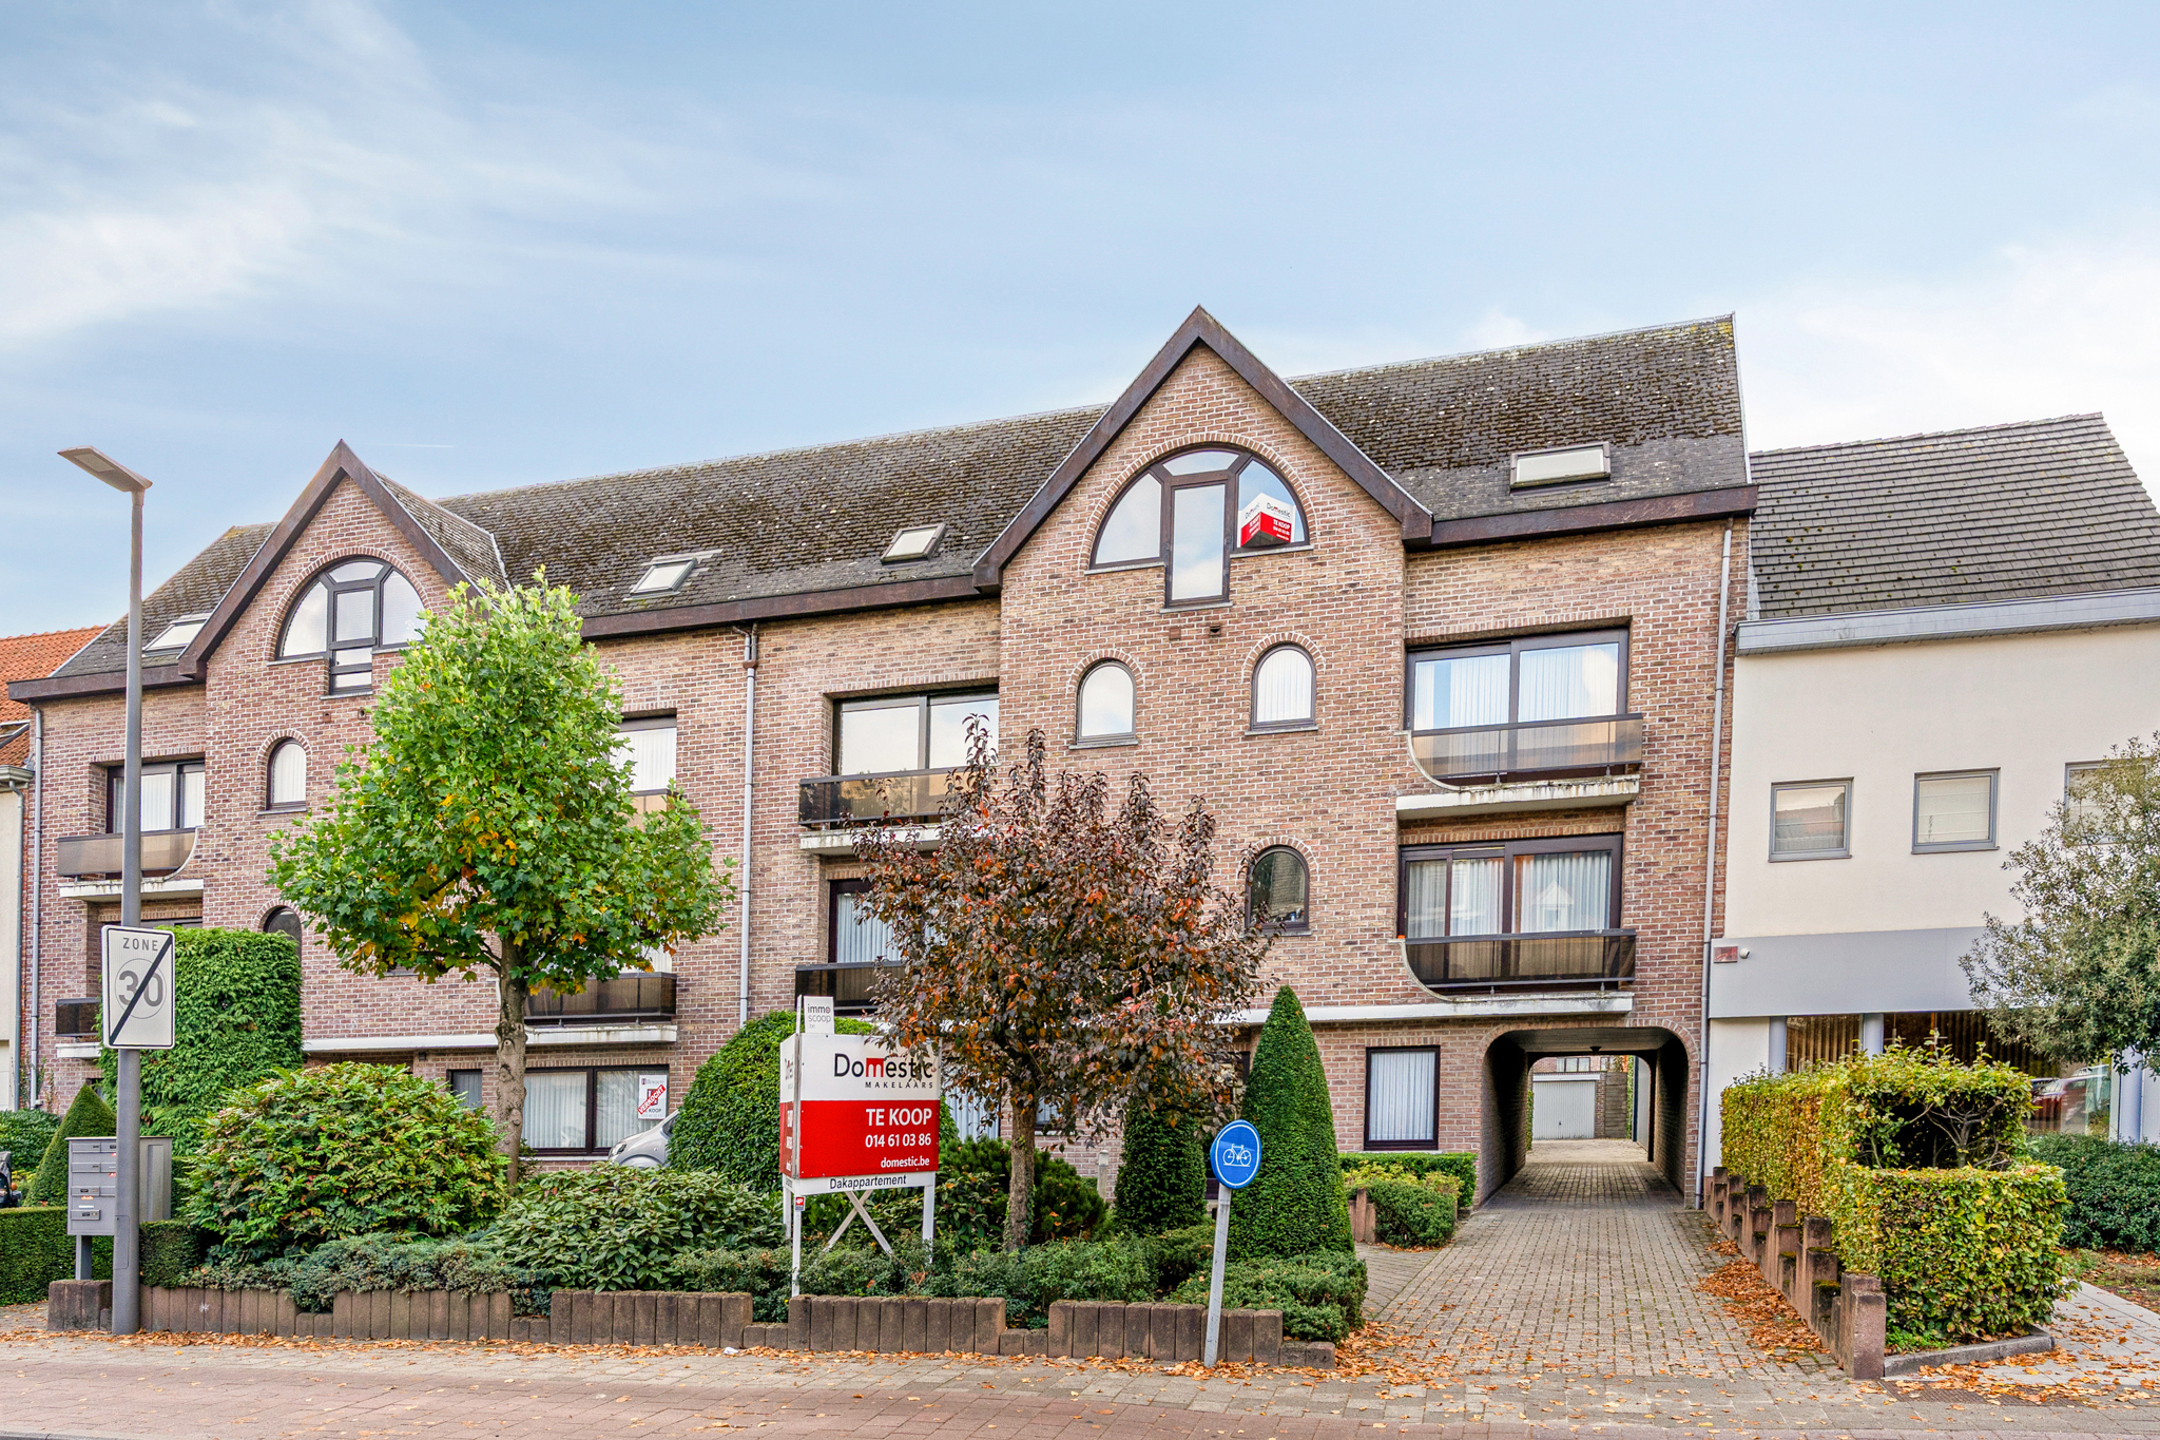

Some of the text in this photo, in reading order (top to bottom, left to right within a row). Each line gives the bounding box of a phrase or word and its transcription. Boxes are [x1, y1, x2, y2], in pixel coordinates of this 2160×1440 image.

[123, 937, 158, 951] ZONE
[118, 970, 164, 1007] 30
[807, 1003, 831, 1014] immo
[808, 1014, 832, 1024] scoop
[865, 1081, 933, 1089] MAKELAARS
[638, 1086, 664, 1113] VERKOCHT
[865, 1107, 933, 1126] TE KOOP
[865, 1132, 932, 1148] 014 61 03 86
[880, 1155, 930, 1168] domestic.be
[829, 1174, 907, 1190] Dakappartement
